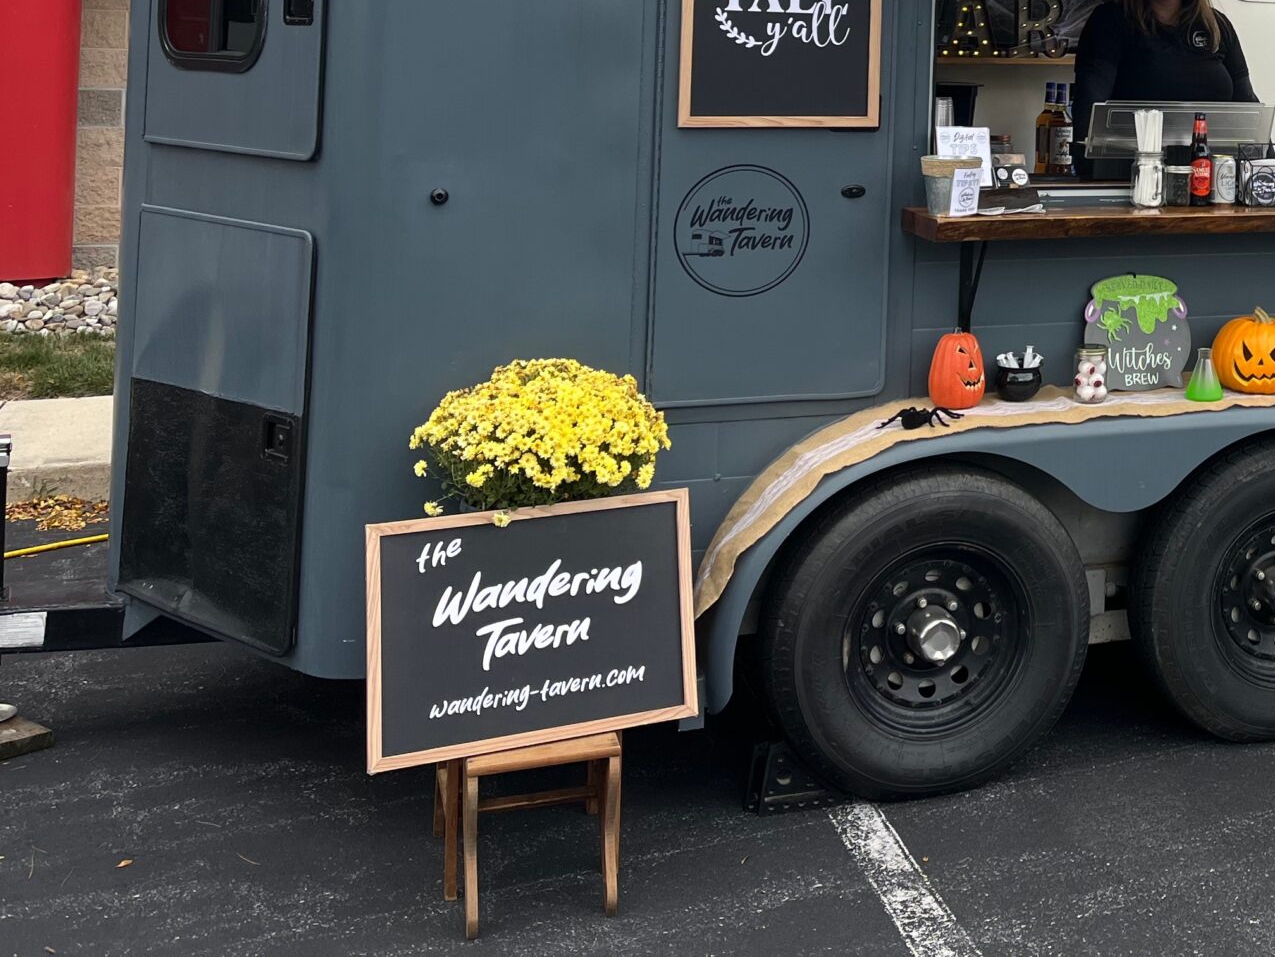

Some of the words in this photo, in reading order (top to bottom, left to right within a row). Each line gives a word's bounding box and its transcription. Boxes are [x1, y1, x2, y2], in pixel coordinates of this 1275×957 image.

[760, 1, 851, 57] y'all
[690, 198, 794, 231] Wandering
[717, 196, 732, 207] the
[728, 227, 794, 257] Tavern
[1108, 342, 1173, 374] Witches
[1125, 372, 1160, 387] BREW
[415, 538, 462, 573] the
[431, 558, 643, 628] Wandering
[475, 616, 591, 671] Tavern
[428, 664, 646, 720] wandering-tavern.com
